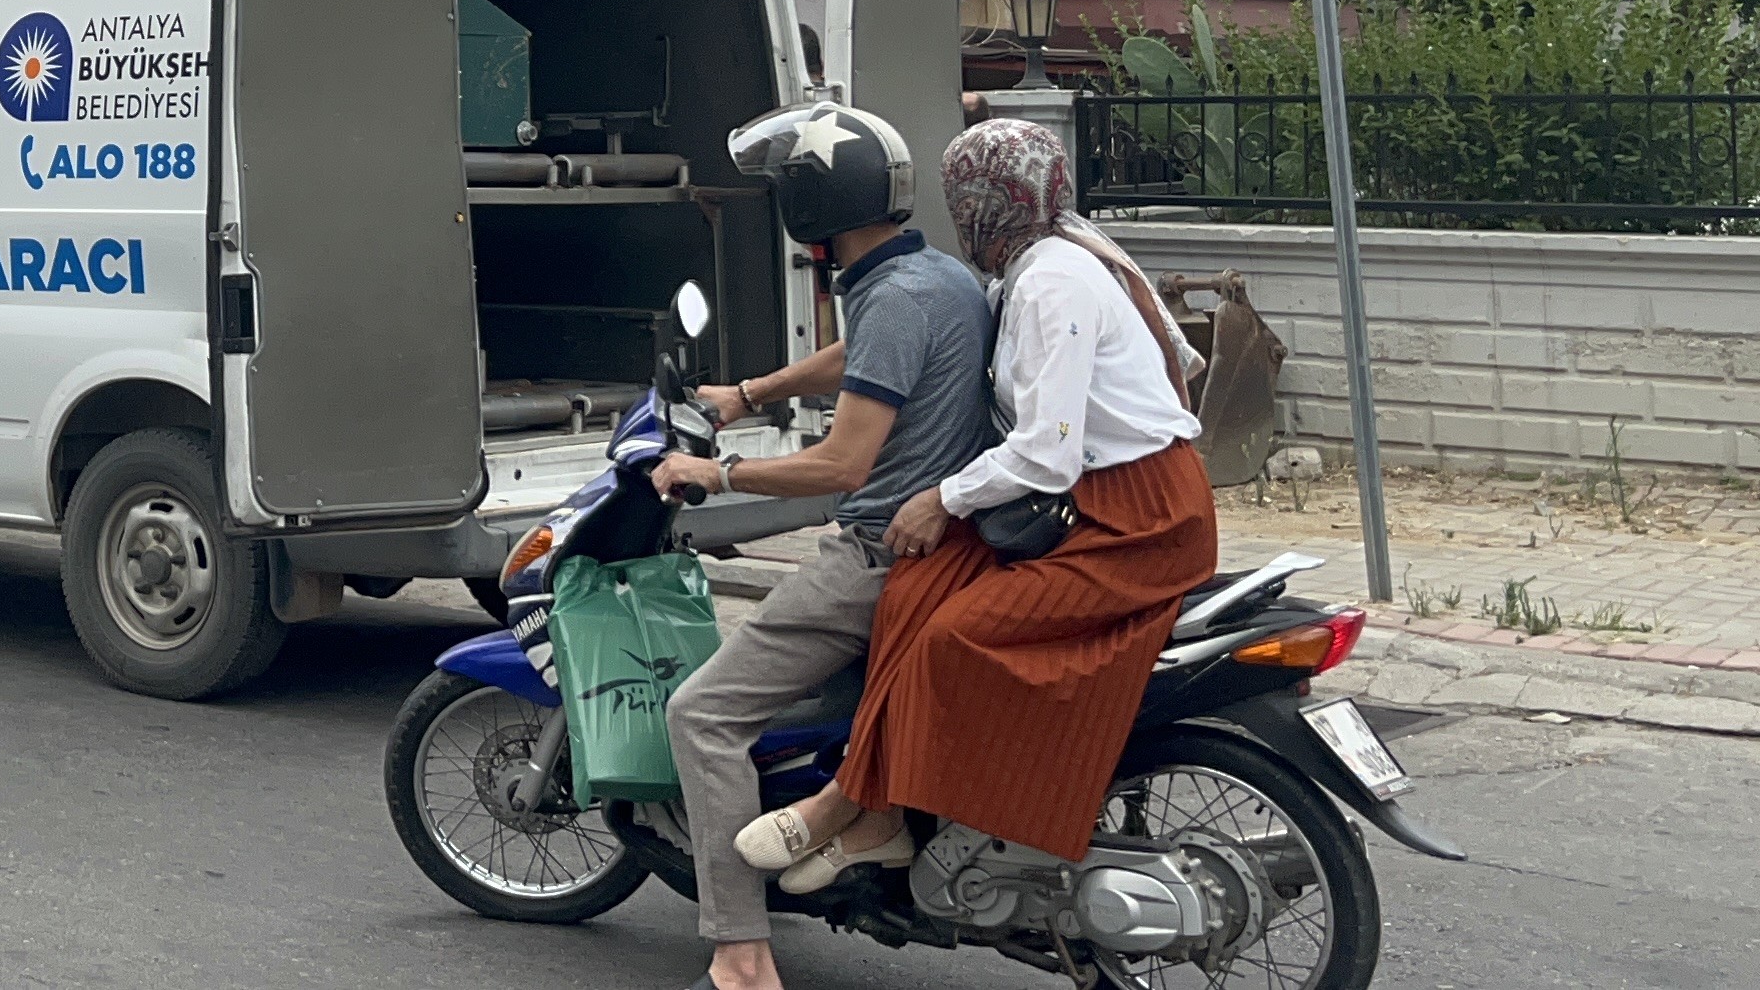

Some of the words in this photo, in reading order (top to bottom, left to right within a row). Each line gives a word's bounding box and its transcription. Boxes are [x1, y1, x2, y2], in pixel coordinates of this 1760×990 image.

[81, 13, 185, 43] ANTALYA
[76, 85, 200, 120] BELEDİYESİ
[46, 144, 124, 180] ALO
[133, 143, 196, 179] 188
[511, 607, 548, 642] YAMAHA
